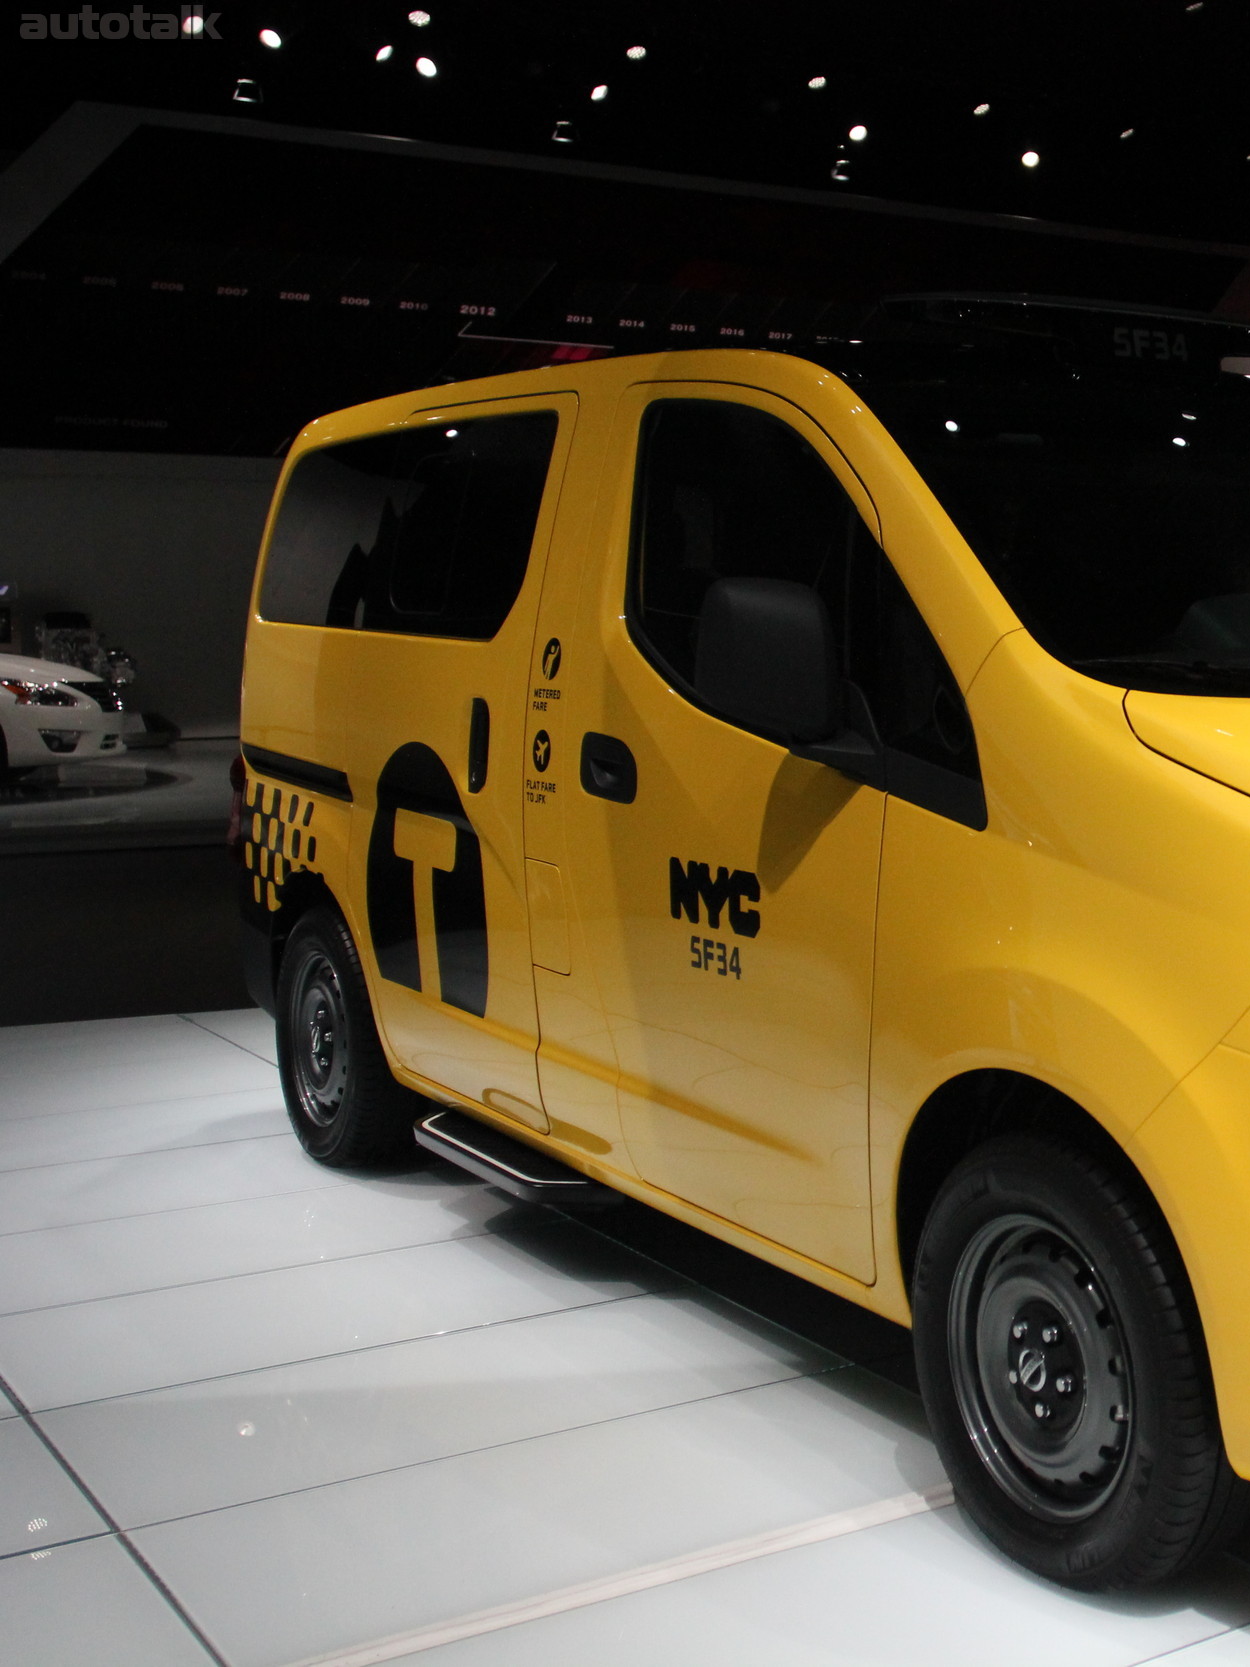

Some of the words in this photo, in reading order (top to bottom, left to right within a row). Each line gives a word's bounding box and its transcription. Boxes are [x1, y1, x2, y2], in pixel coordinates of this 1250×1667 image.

[217, 285, 248, 297] 2007
[279, 291, 310, 301] 2008
[340, 296, 370, 306] 2009
[400, 300, 429, 311] 2010
[459, 304, 496, 316] 2012
[566, 314, 593, 324] 2013
[619, 318, 645, 328] 2014
[670, 323, 696, 333] 2015
[720, 327, 745, 336] 2016
[768, 331, 793, 340] 2017
[534, 688, 561, 700] METERED
[532, 701, 548, 711] FARE
[526, 779, 540, 791] FLAT
[541, 781, 556, 793] FARE
[526, 792, 534, 803] TO
[534, 793, 546, 804] JFK
[669, 856, 761, 938] NYC
